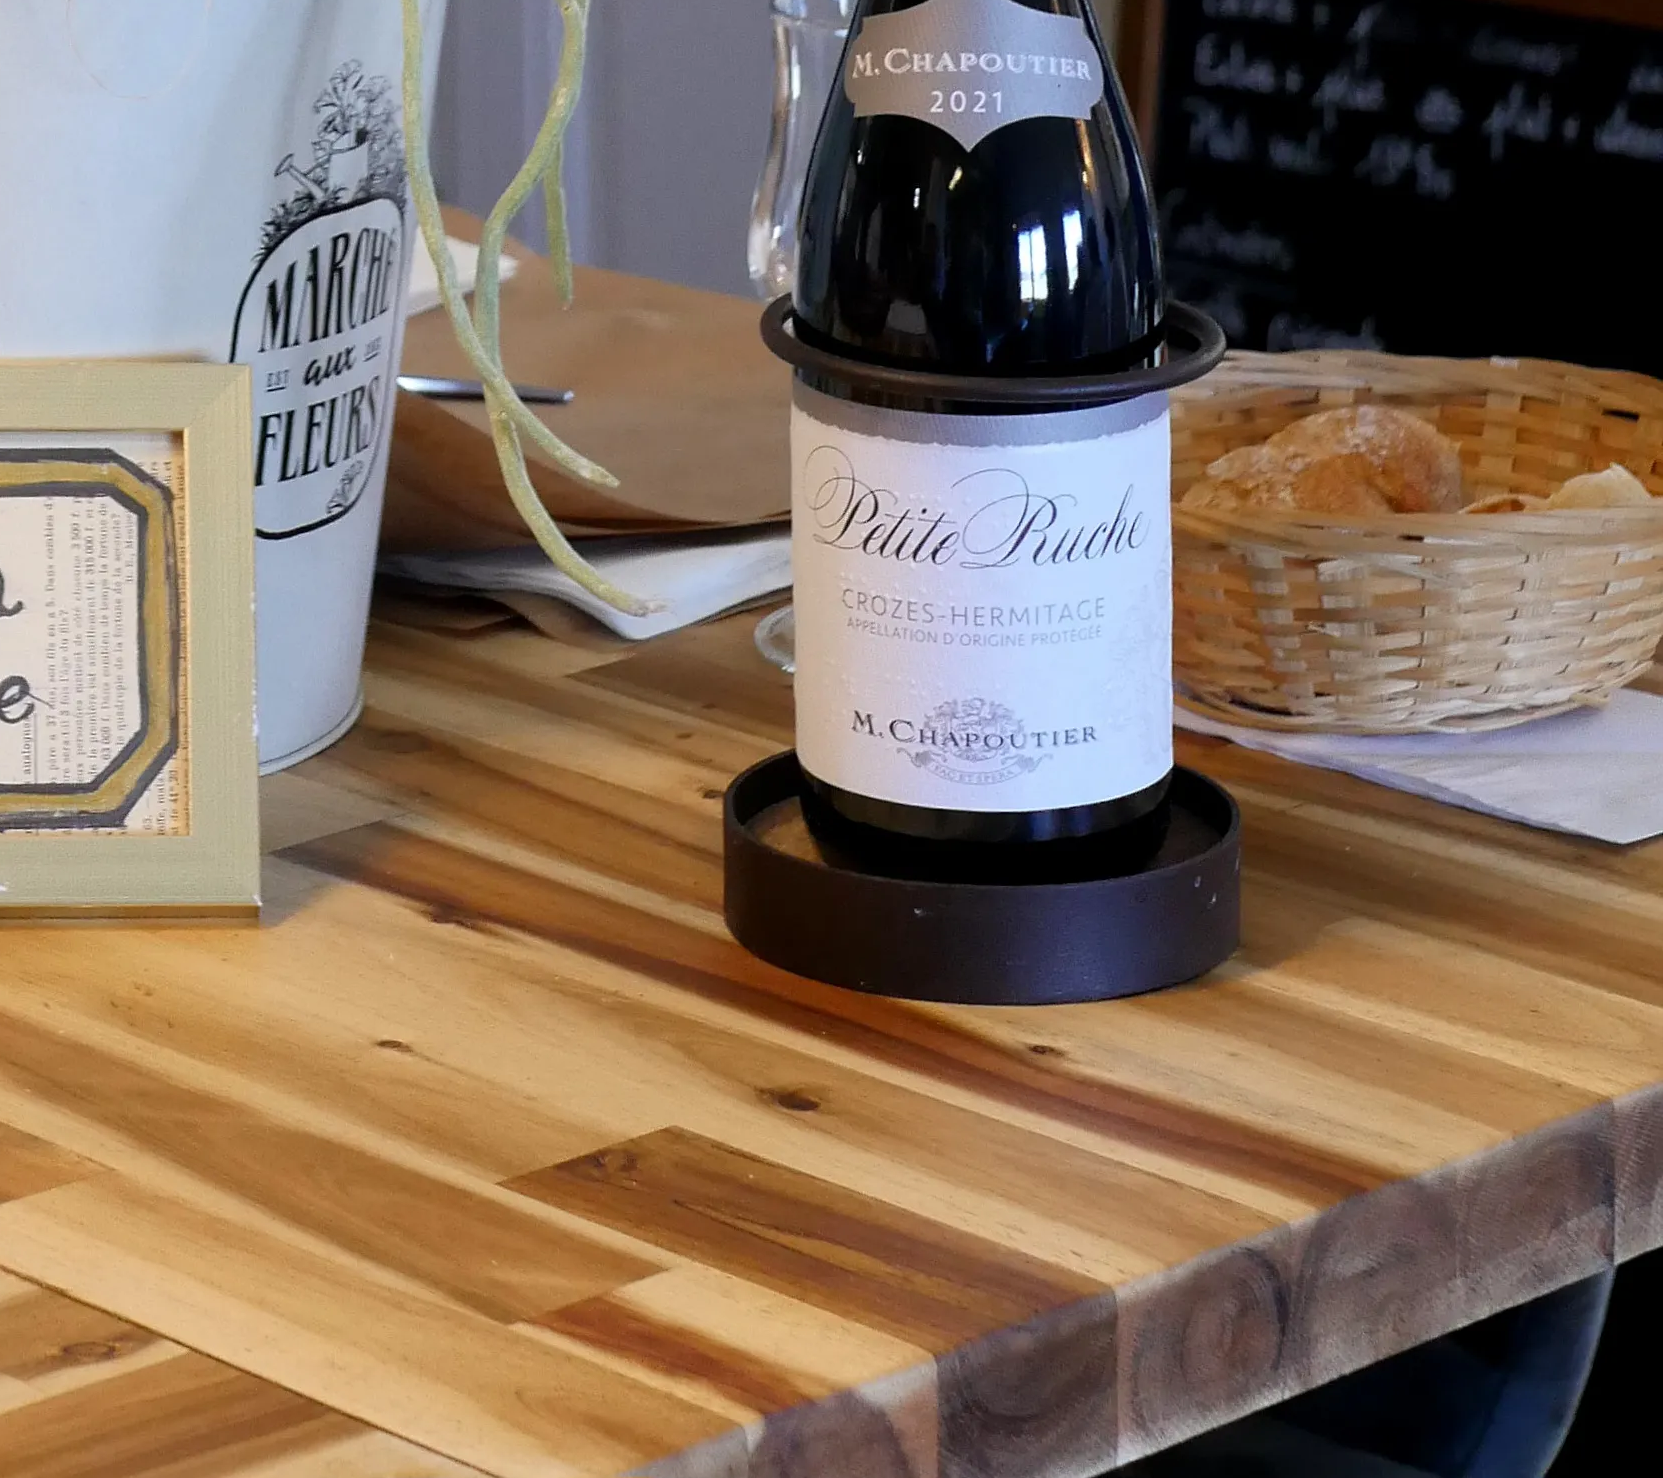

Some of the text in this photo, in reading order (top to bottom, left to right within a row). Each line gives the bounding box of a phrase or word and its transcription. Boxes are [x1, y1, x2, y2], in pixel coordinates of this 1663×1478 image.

[929, 89, 1003, 114] 2021
[303, 345, 357, 387] aux
[253, 375, 381, 487] FLEURS
[804, 445, 1152, 569] Petite Ruche
[842, 588, 1106, 628] CROZES-HERMITAGE
[846, 616, 938, 644] APPELLATION
[943, 631, 1026, 648] D'ORIGINE
